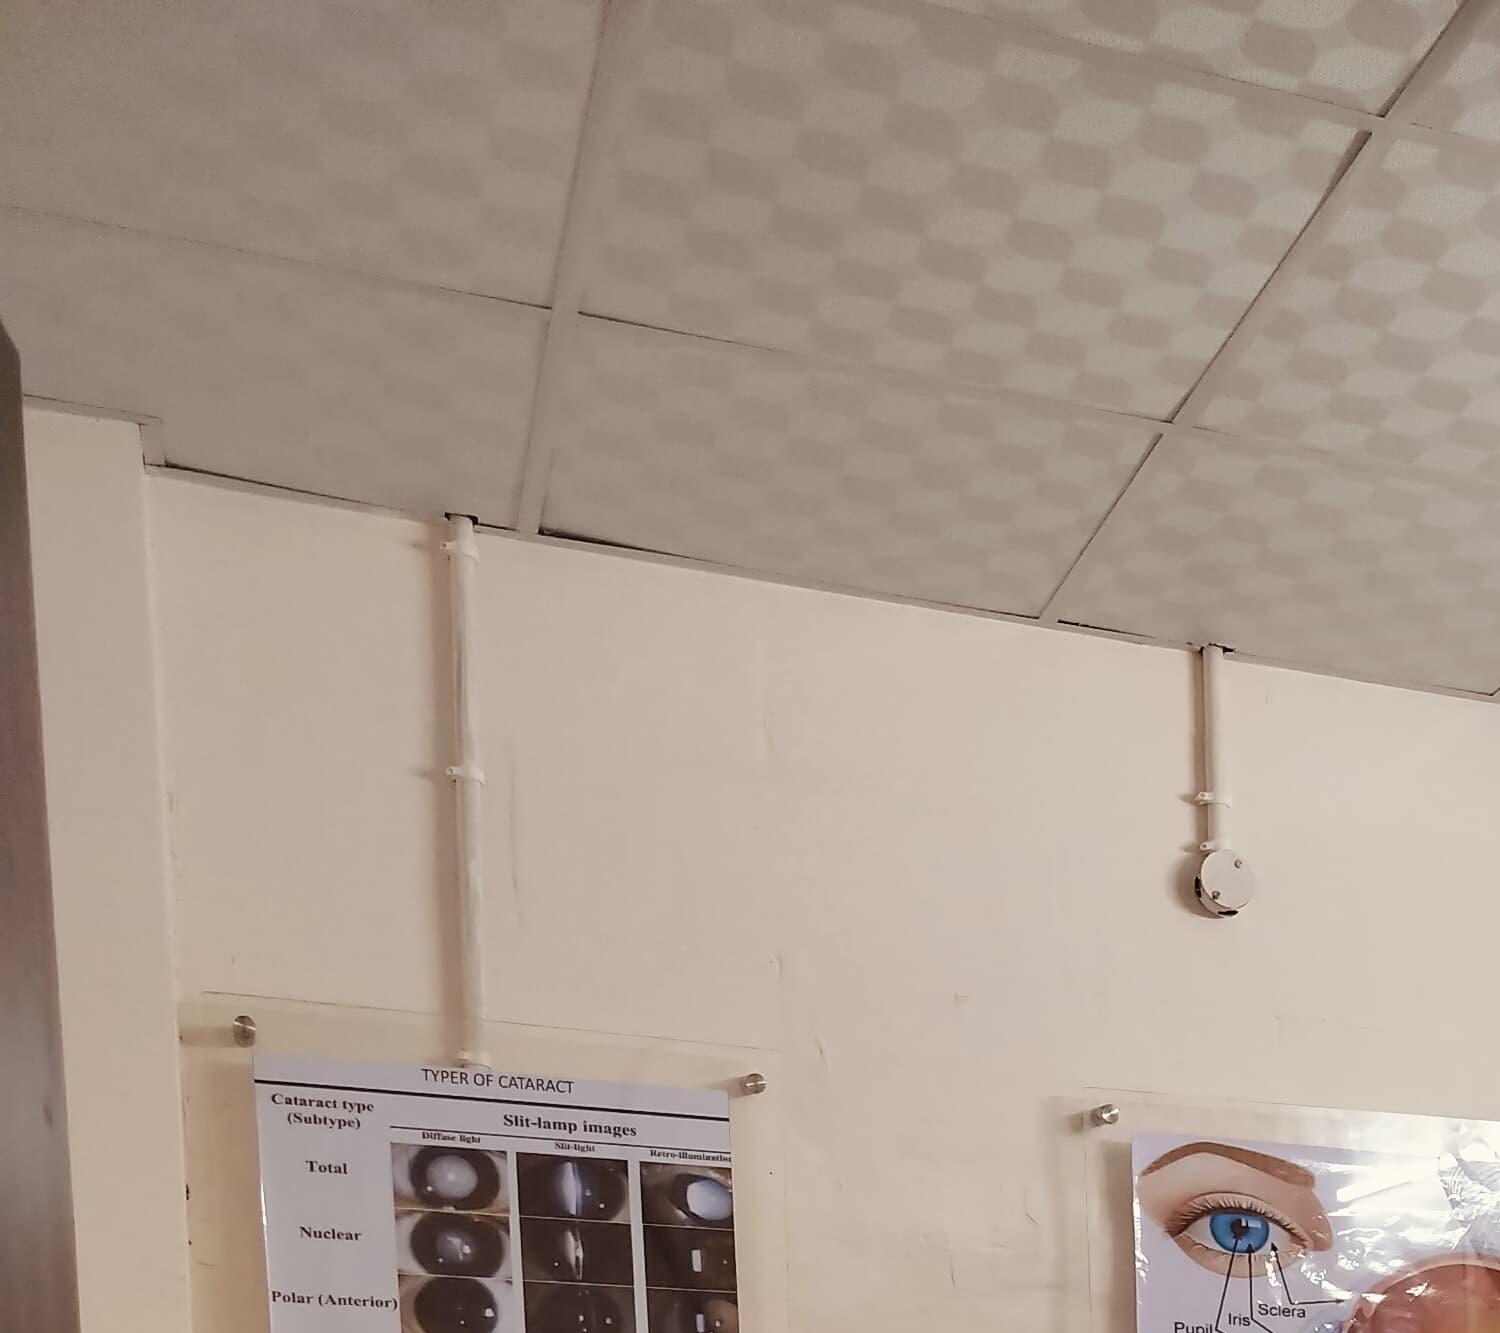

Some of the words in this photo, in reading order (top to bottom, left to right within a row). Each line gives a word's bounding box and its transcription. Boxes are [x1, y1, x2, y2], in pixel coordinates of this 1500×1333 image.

[422, 1069, 468, 1085] TYPER
[474, 1072, 494, 1087] OF
[498, 1074, 573, 1094] CATARACT
[271, 1093, 333, 1110] Cataract
[338, 1099, 374, 1114] type
[287, 1111, 361, 1130] (Subtype)
[503, 1114, 577, 1137] Slit-lamp
[582, 1119, 637, 1138] images
[305, 1160, 347, 1175] Total
[300, 1227, 361, 1242] Nuclear
[271, 1291, 312, 1306] Polar
[317, 1293, 398, 1311] (Anterior)
[1228, 1312, 1251, 1327] Iris
[1258, 1303, 1306, 1319] Sclera
